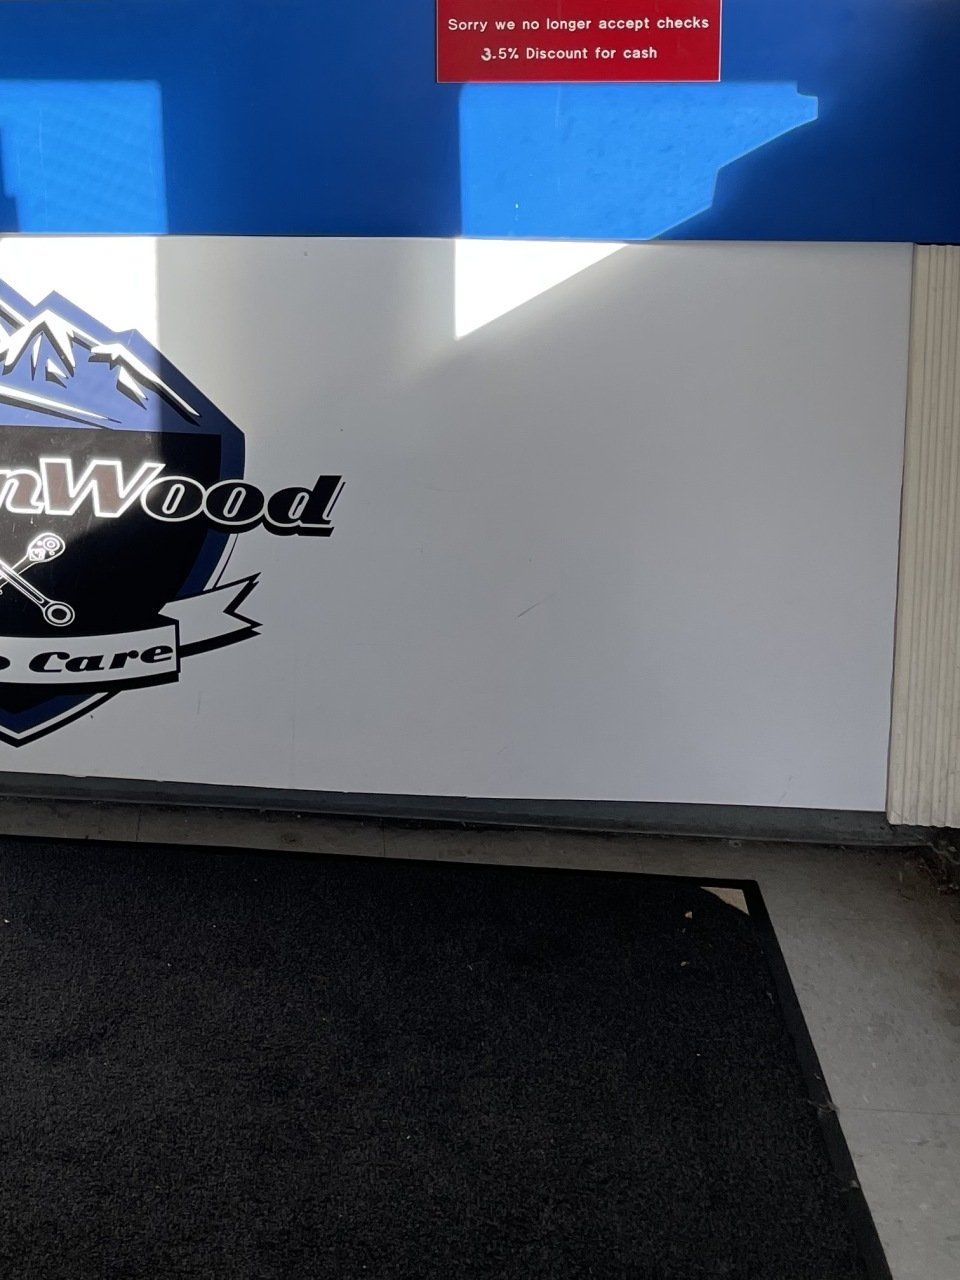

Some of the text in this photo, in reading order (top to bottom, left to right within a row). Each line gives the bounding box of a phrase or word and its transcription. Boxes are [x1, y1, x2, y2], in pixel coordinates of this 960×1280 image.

[448, 16, 710, 32] Sorry we no longer accept checks
[481, 46, 658, 61] 3.5% Discount for cash
[28, 645, 174, 673] Care
